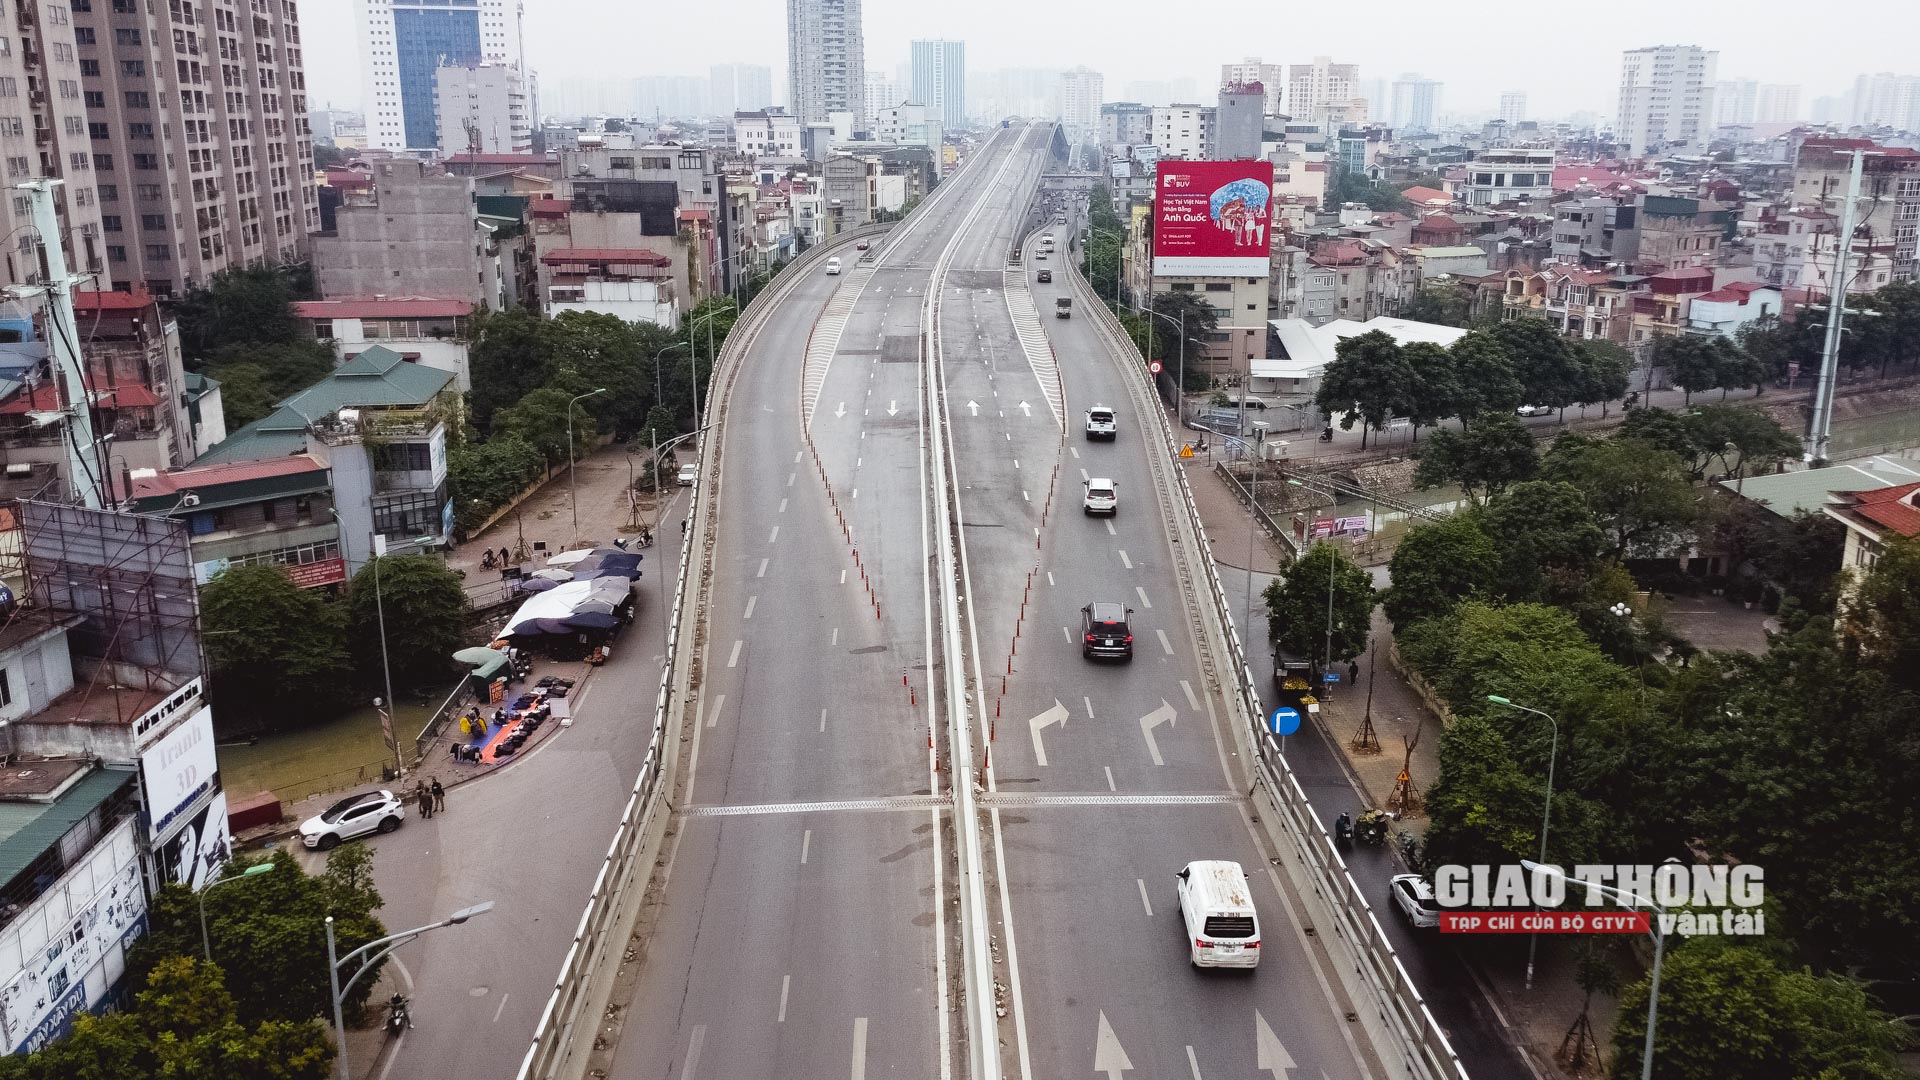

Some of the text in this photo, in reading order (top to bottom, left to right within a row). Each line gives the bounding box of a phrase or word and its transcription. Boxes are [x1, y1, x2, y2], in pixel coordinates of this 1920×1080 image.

[1163, 212, 1207, 222] Anh Quốc
[157, 725, 203, 771] Tranh
[176, 764, 198, 797] 3D
